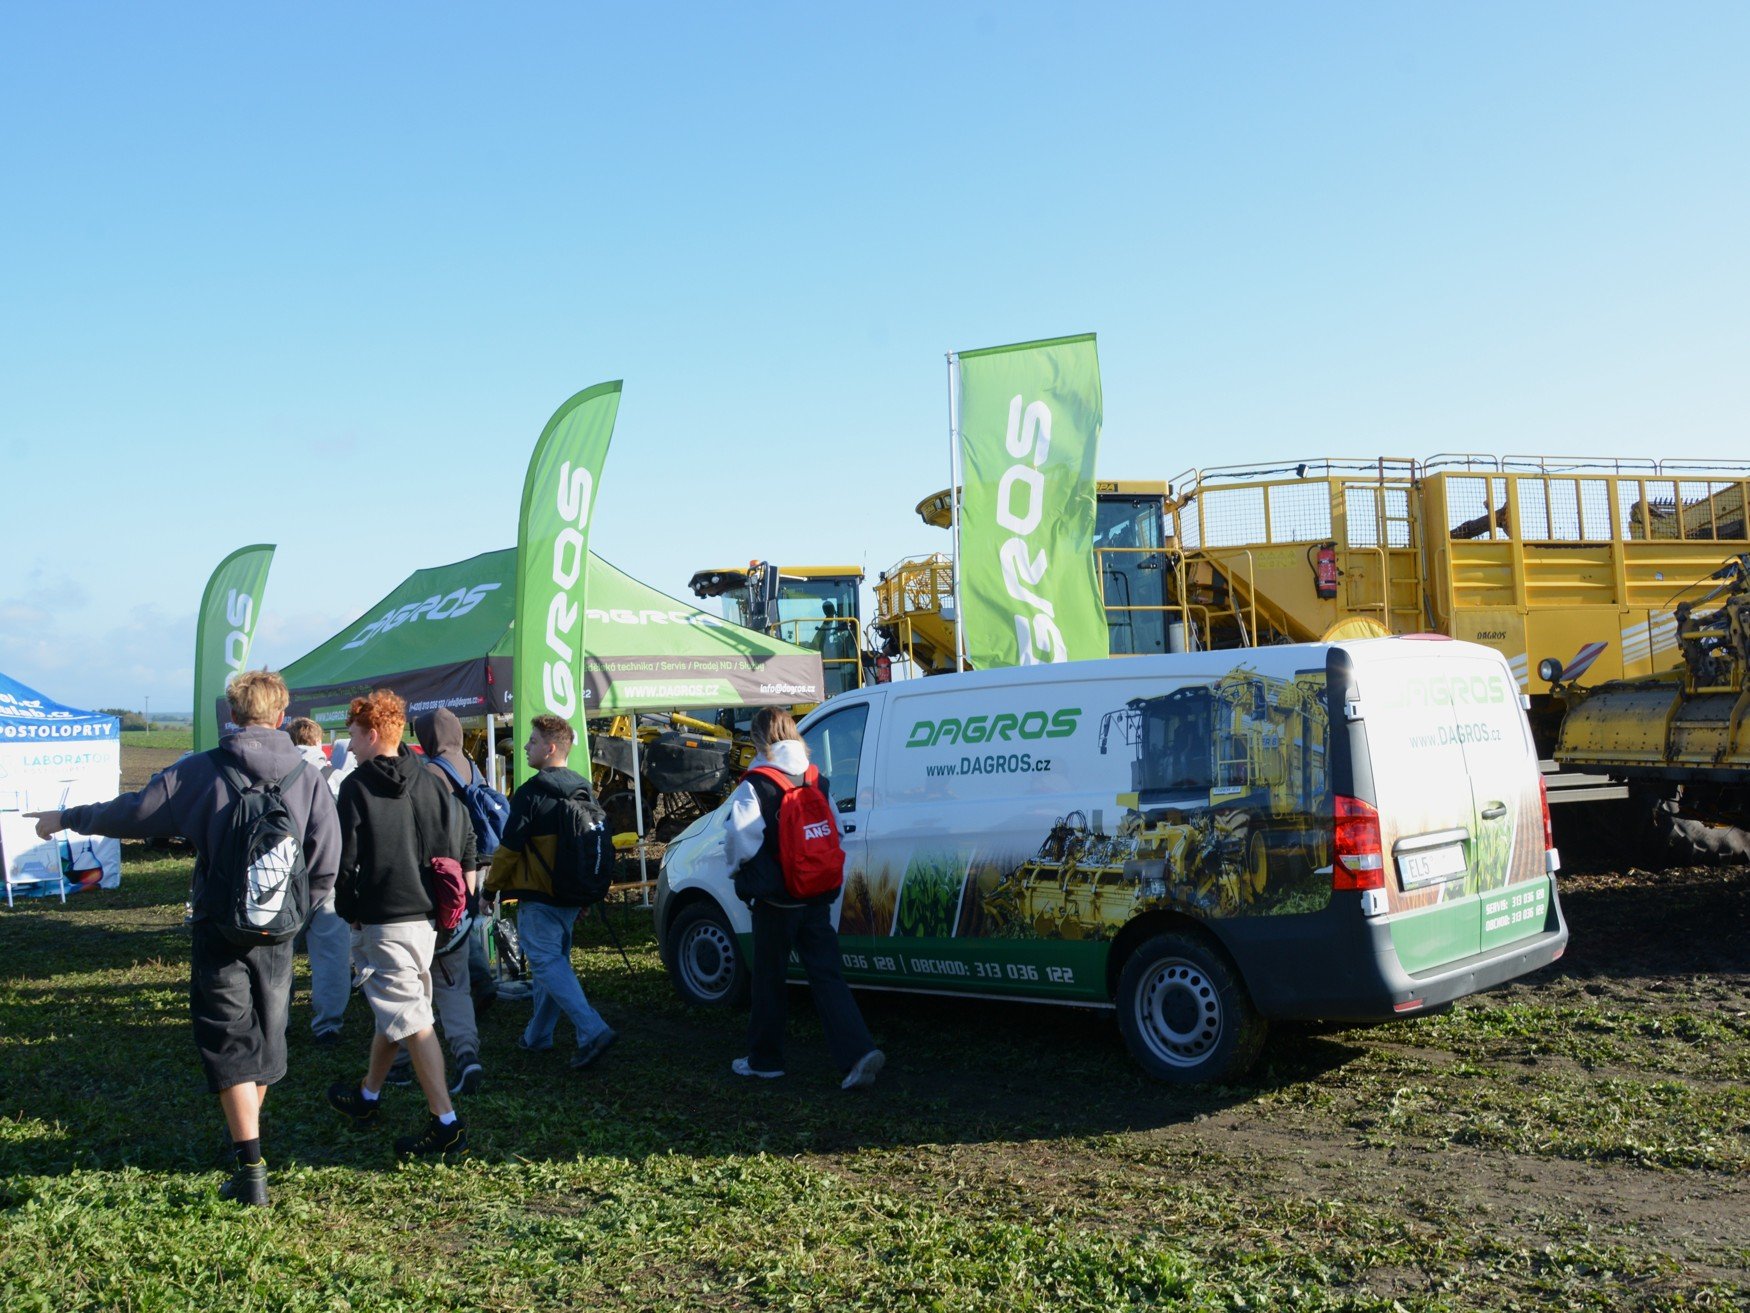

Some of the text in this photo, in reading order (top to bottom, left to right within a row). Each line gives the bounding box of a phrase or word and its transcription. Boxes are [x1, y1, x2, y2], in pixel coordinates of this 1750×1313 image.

[543, 460, 593, 745] GROS
[341, 583, 502, 650] DAGROS
[225, 588, 253, 694] OS
[1476, 631, 1506, 640] DAGROS
[616, 662, 653, 672] technika
[660, 661, 687, 671] Servis
[693, 662, 719, 672] Prodej
[720, 662, 732, 670] ND
[624, 683, 719, 698] WWW.DAGROS.CZ
[760, 683, 816, 695] info@dagros.cz
[905, 708, 1082, 748] DAGROS
[1409, 723, 1502, 749] www.DAGROS.cz
[926, 753, 1051, 777] www.DAGROS.cz
[803, 819, 831, 841] ANS
[842, 954, 868, 969] 036
[873, 956, 896, 971] 128
[911, 958, 970, 976] OBCHOD:
[976, 962, 1001, 978] 313
[1007, 964, 1039, 981] 036
[1046, 967, 1075, 983] 122
